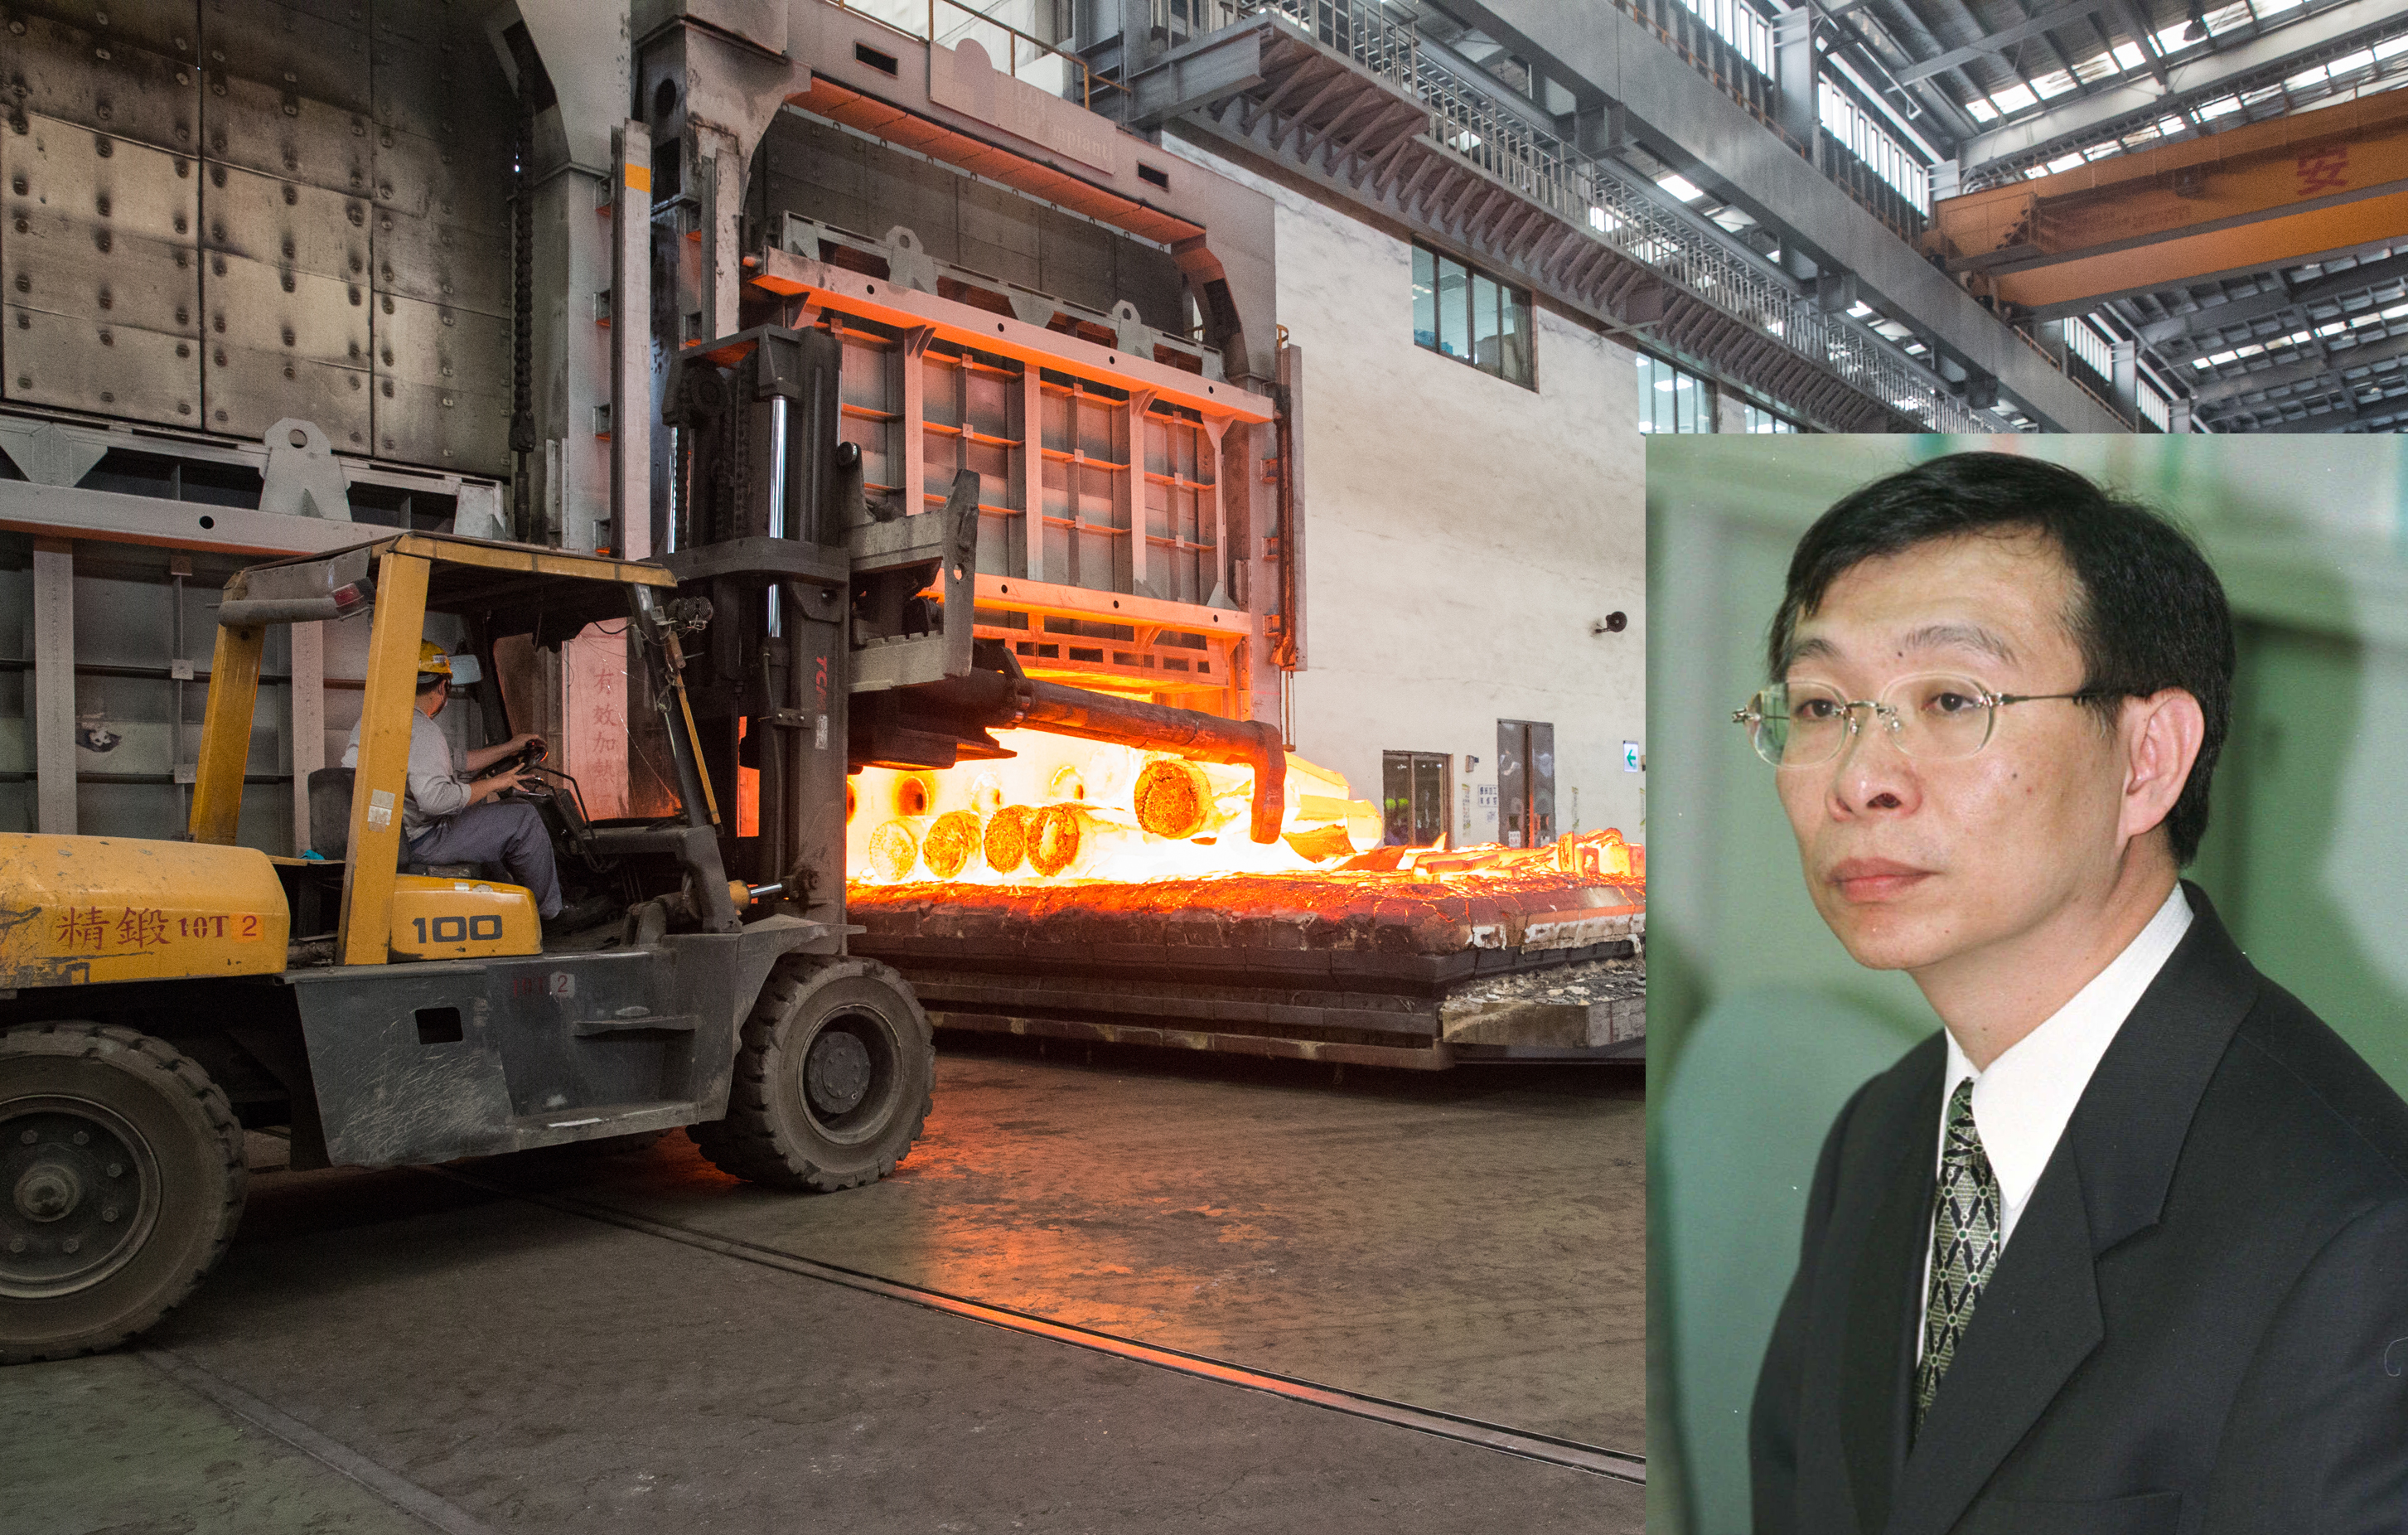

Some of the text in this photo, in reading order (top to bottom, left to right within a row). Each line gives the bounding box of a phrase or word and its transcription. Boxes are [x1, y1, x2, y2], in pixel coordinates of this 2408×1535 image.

[2297, 144, 2348, 196] 安
[592, 668, 617, 816] 有效加熱
[56, 906, 257, 950] 精鍛 10T 2
[412, 915, 503, 943] 100
[557, 974, 568, 993] 2
